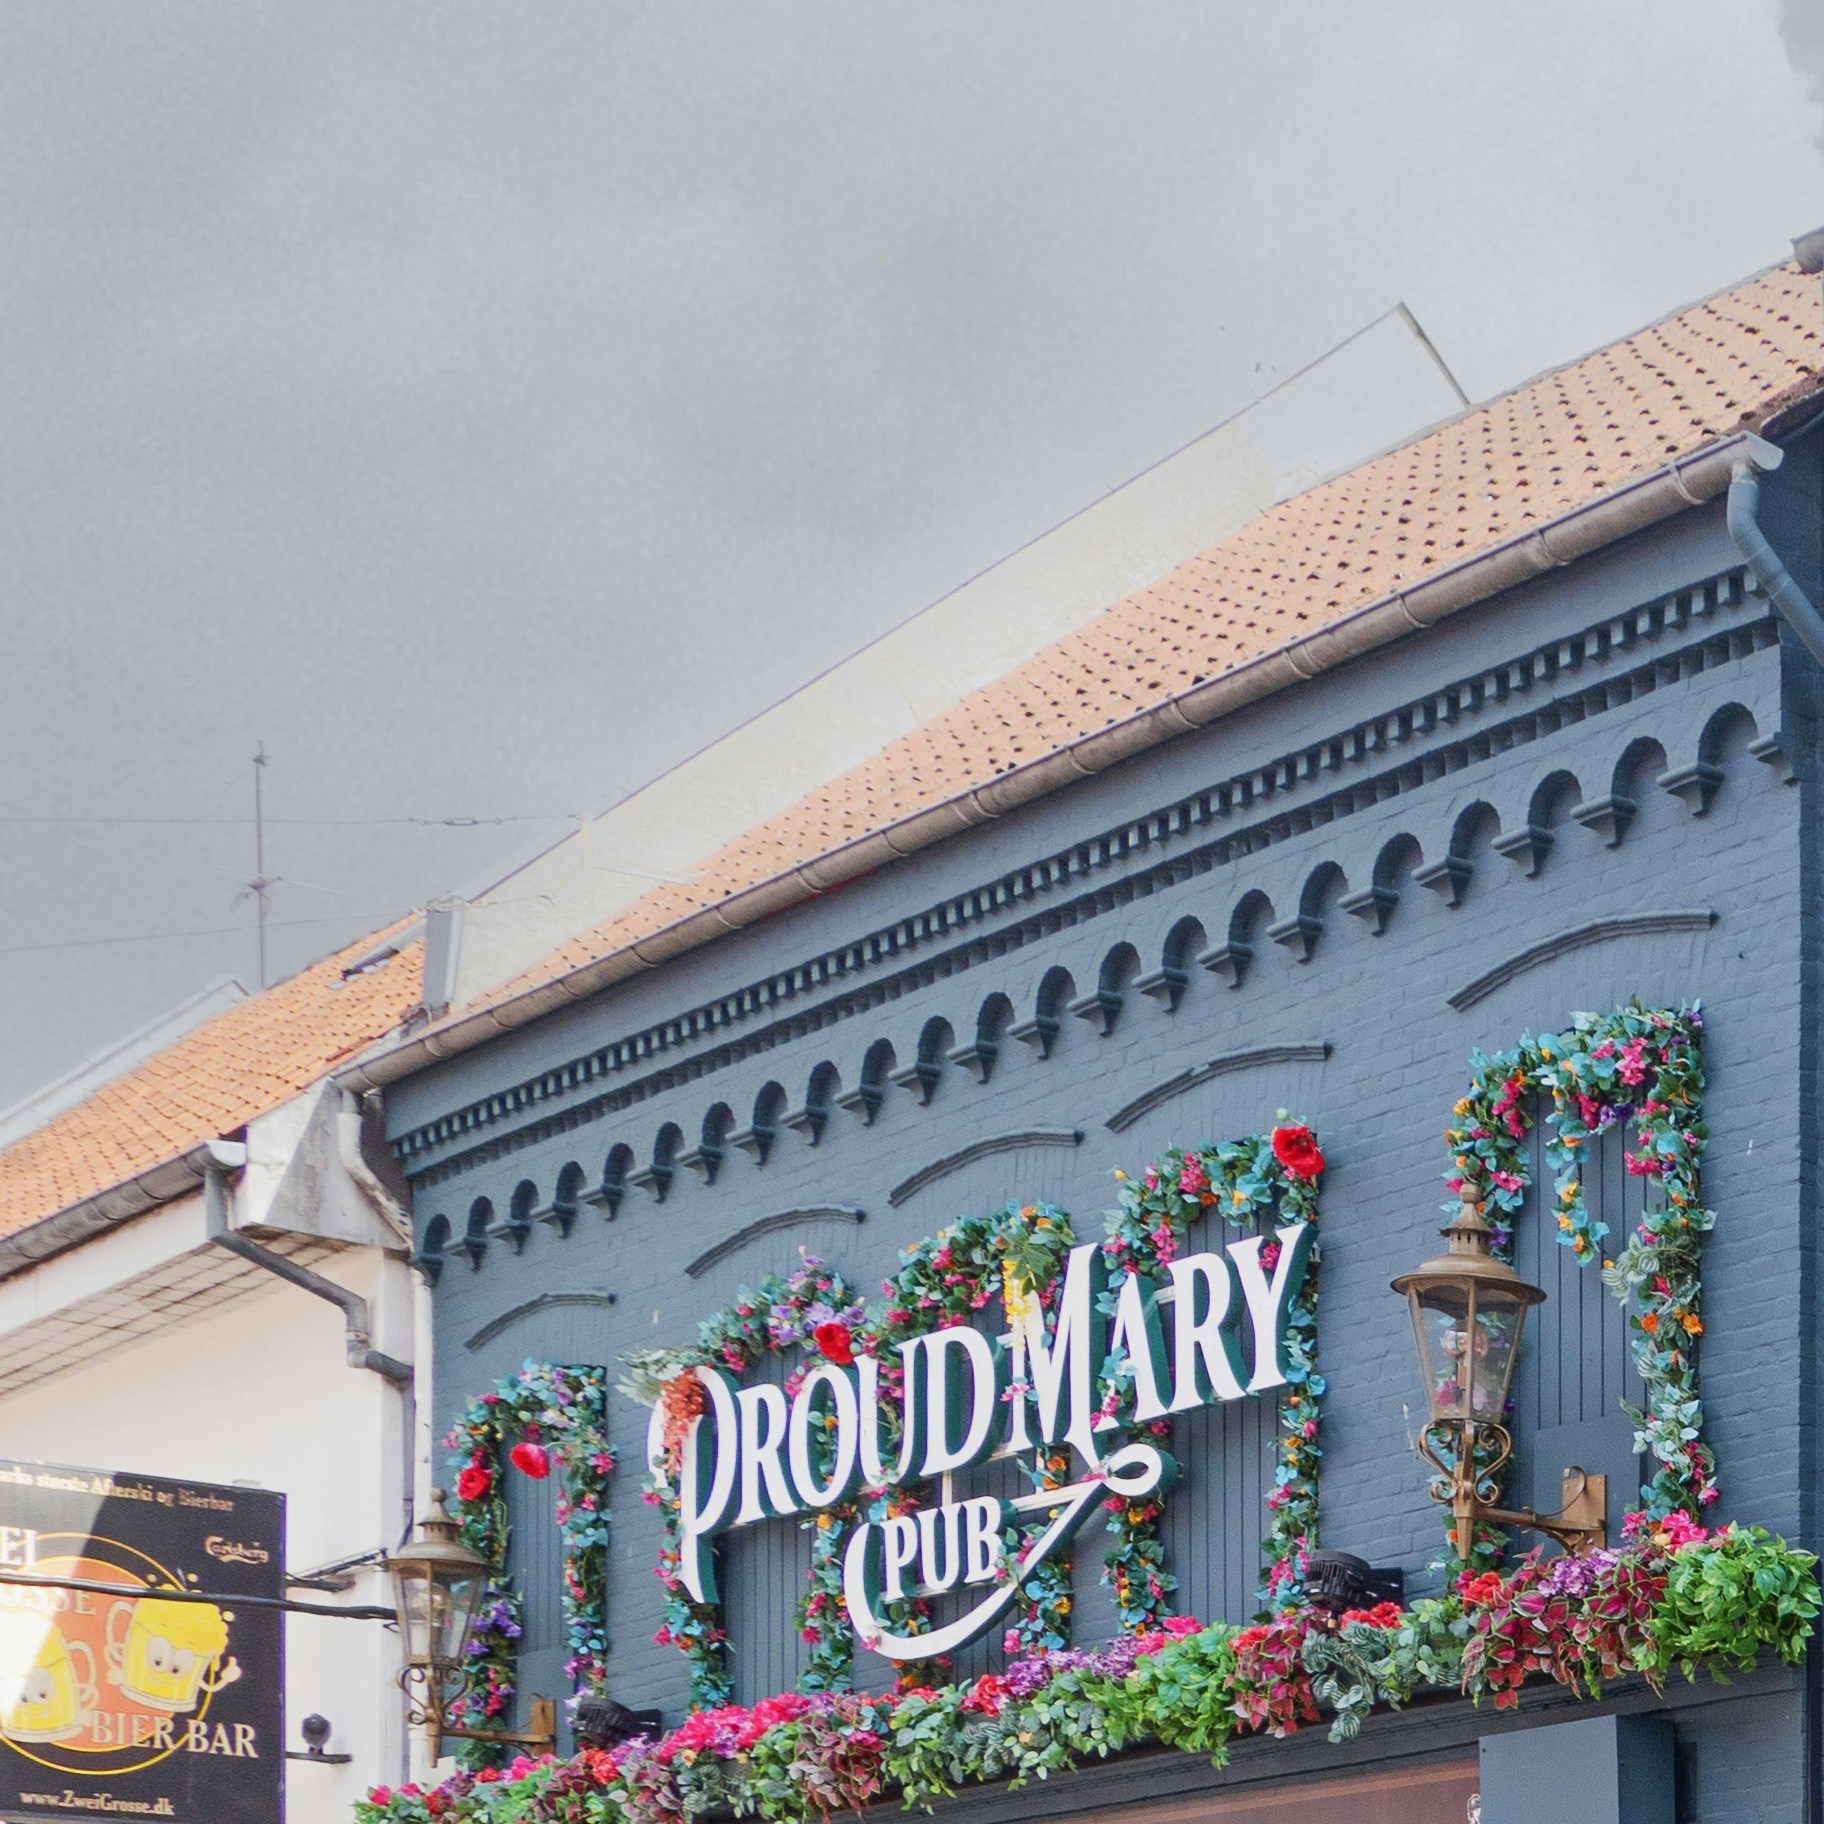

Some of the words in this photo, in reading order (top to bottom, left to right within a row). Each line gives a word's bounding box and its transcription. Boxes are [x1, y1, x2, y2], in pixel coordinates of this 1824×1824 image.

[648, 1325, 997, 1603] PROUD
[1002, 1224, 1307, 1475] MARY
[882, 1495, 1002, 1602] PUB
[90, 1710, 176, 1750] BIER
[187, 1719, 259, 1758] BAR
